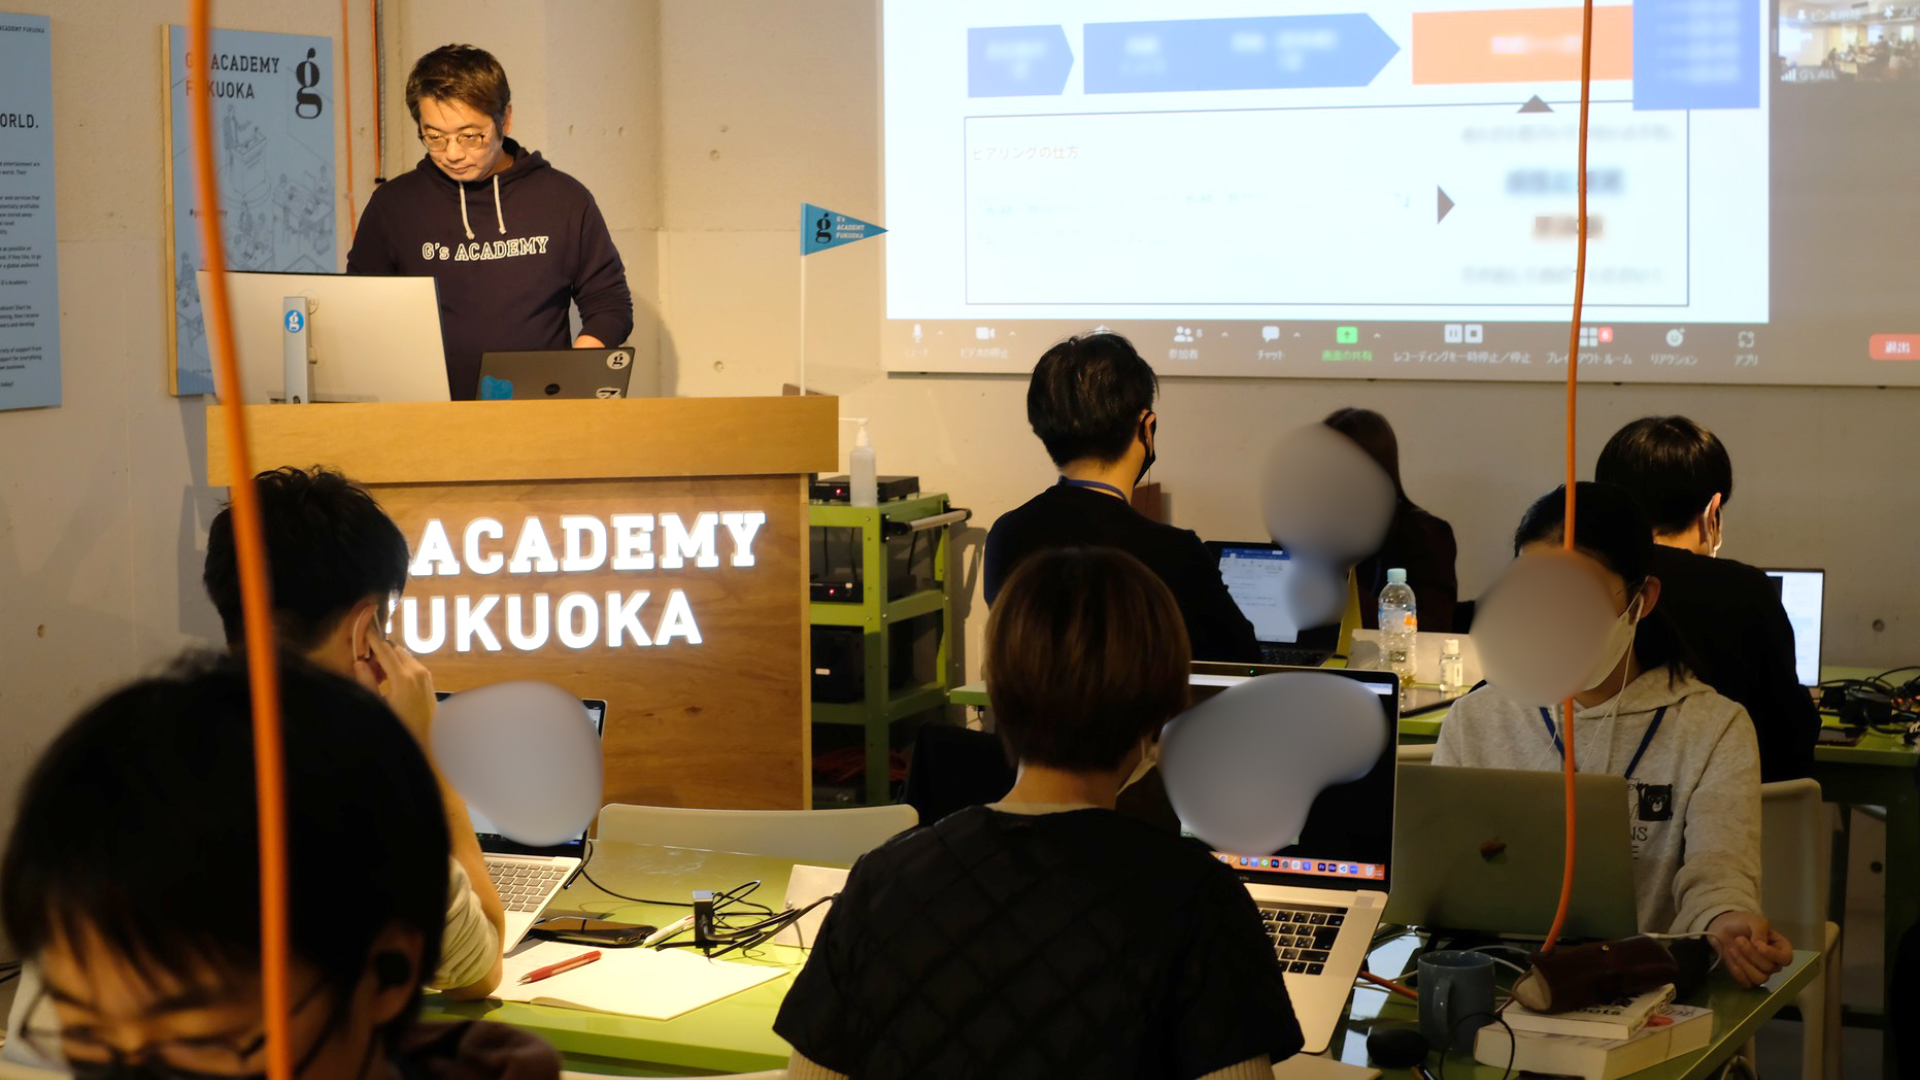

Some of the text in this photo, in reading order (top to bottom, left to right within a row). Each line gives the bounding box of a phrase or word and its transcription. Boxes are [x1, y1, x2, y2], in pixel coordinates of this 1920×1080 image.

[210, 53, 280, 74] ACADEMY
[185, 80, 255, 99] FKUOKA
[0, 113, 39, 128] ORLD.
[973, 145, 1080, 161] ヒアリングの仕方
[421, 235, 550, 262] G's ACADEMY
[409, 510, 767, 577] ACADEMY
